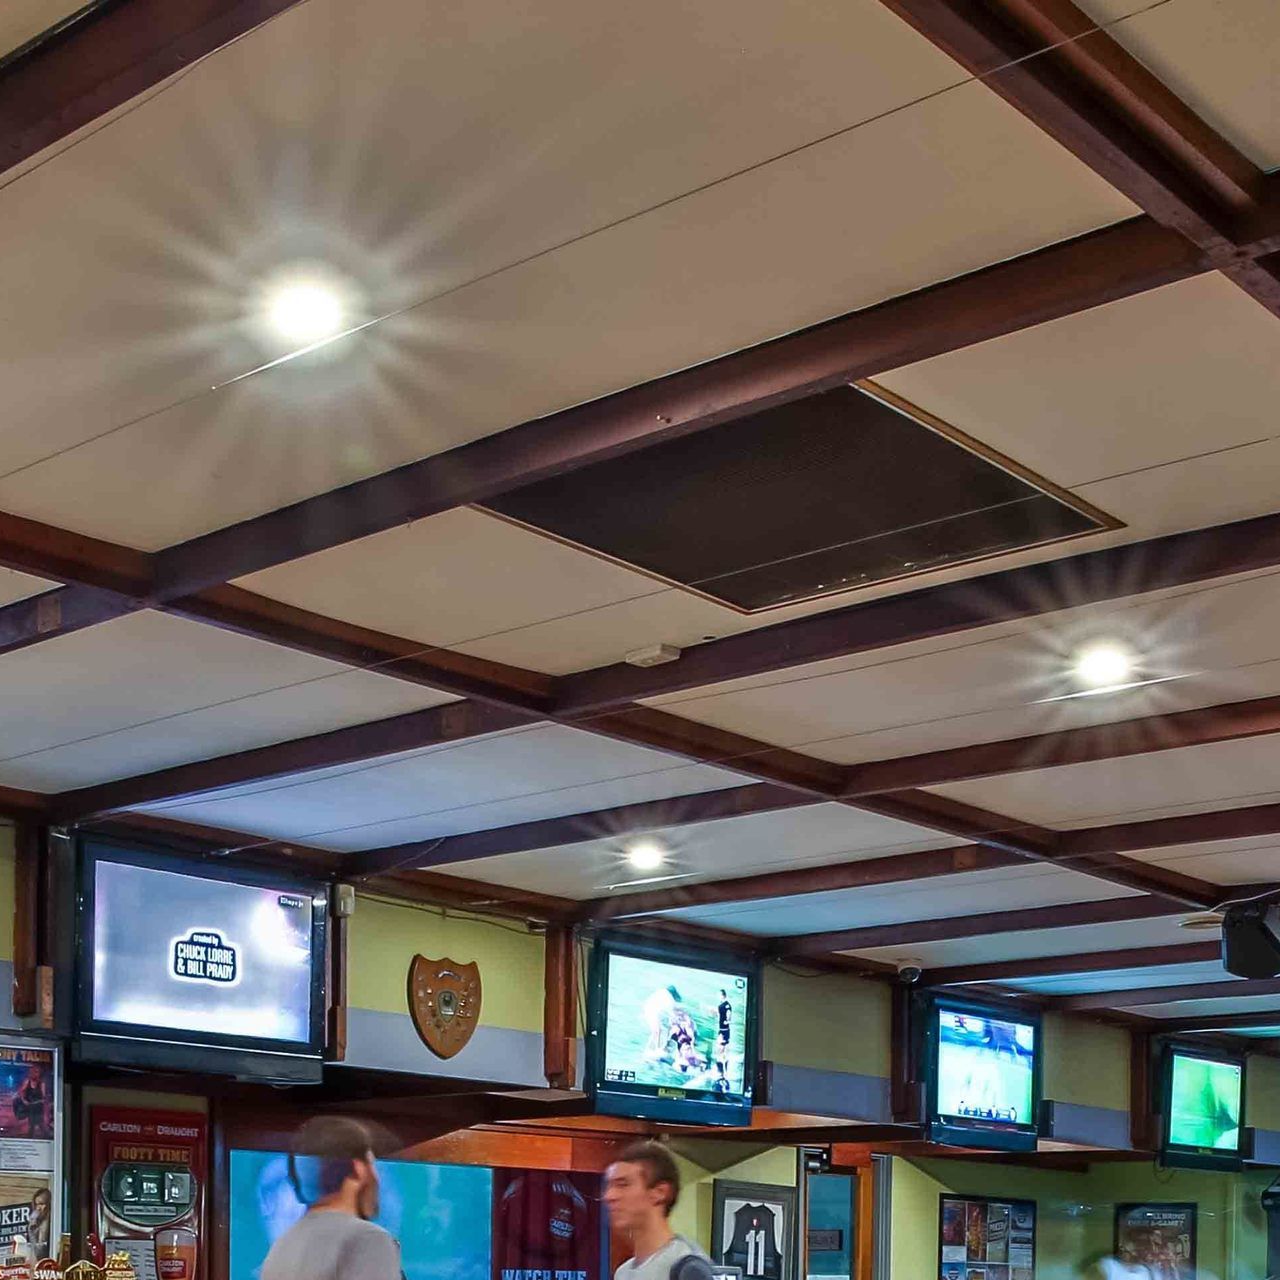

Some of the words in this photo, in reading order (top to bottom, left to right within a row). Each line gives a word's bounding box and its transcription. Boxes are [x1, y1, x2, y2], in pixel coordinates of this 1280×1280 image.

[177, 944, 206, 961] CHUCK
[207, 947, 234, 965] LORRE
[177, 958, 185, 973] &
[187, 961, 205, 976] BILL
[206, 964, 234, 980] PRADY
[99, 1121, 141, 1133] CARLTON
[156, 1124, 200, 1138] DRAUGHT
[113, 1146, 156, 1160] FOOTY
[158, 1149, 189, 1163] TIME
[745, 1230, 767, 1275] 11
[34, 1270, 63, 1280] SWAN
